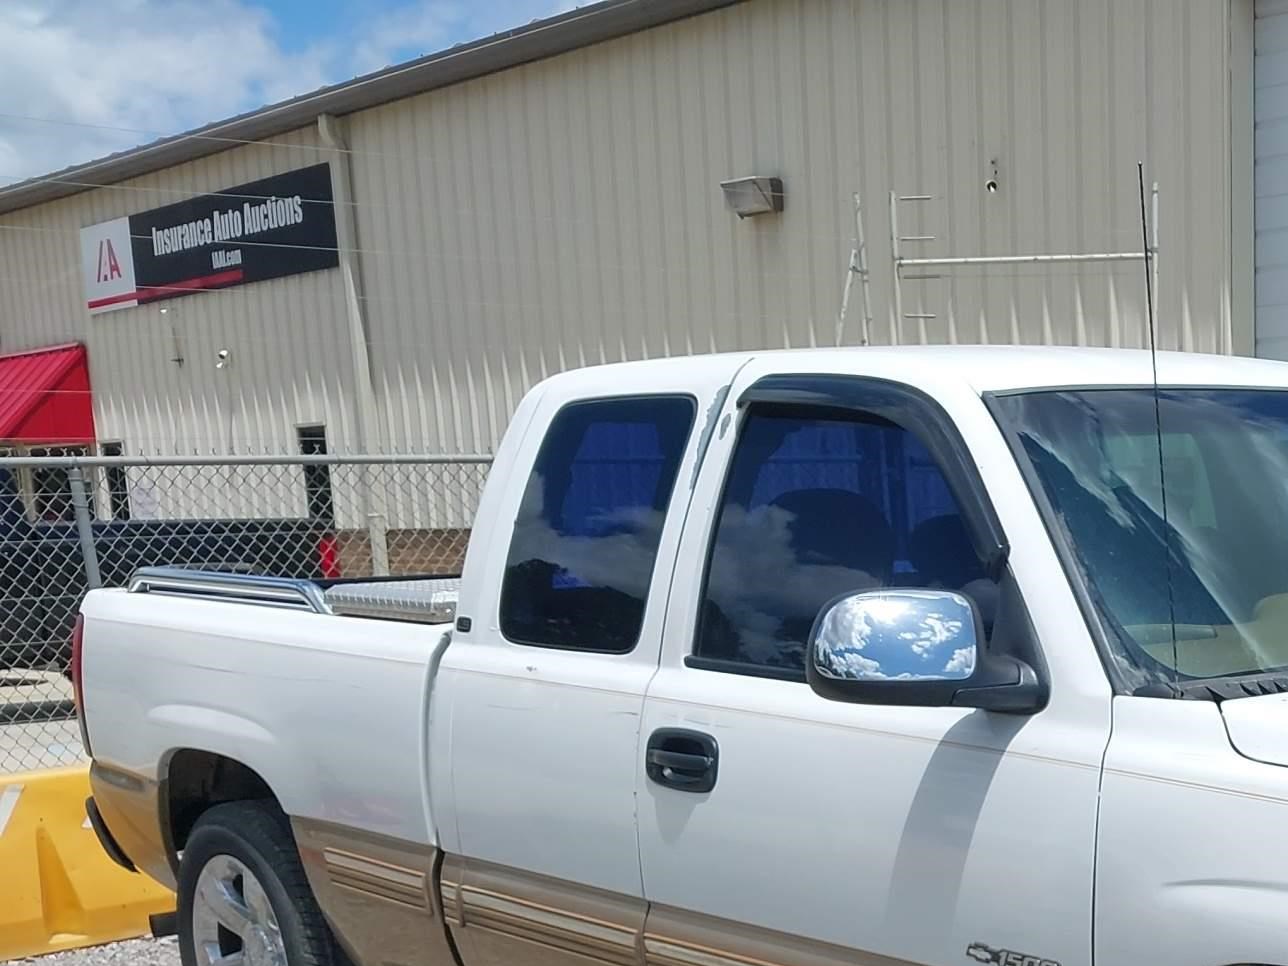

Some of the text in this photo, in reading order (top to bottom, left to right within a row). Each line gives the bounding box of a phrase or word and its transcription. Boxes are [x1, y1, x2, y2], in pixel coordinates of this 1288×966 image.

[152, 195, 304, 257] Insurance Auto Auctions
